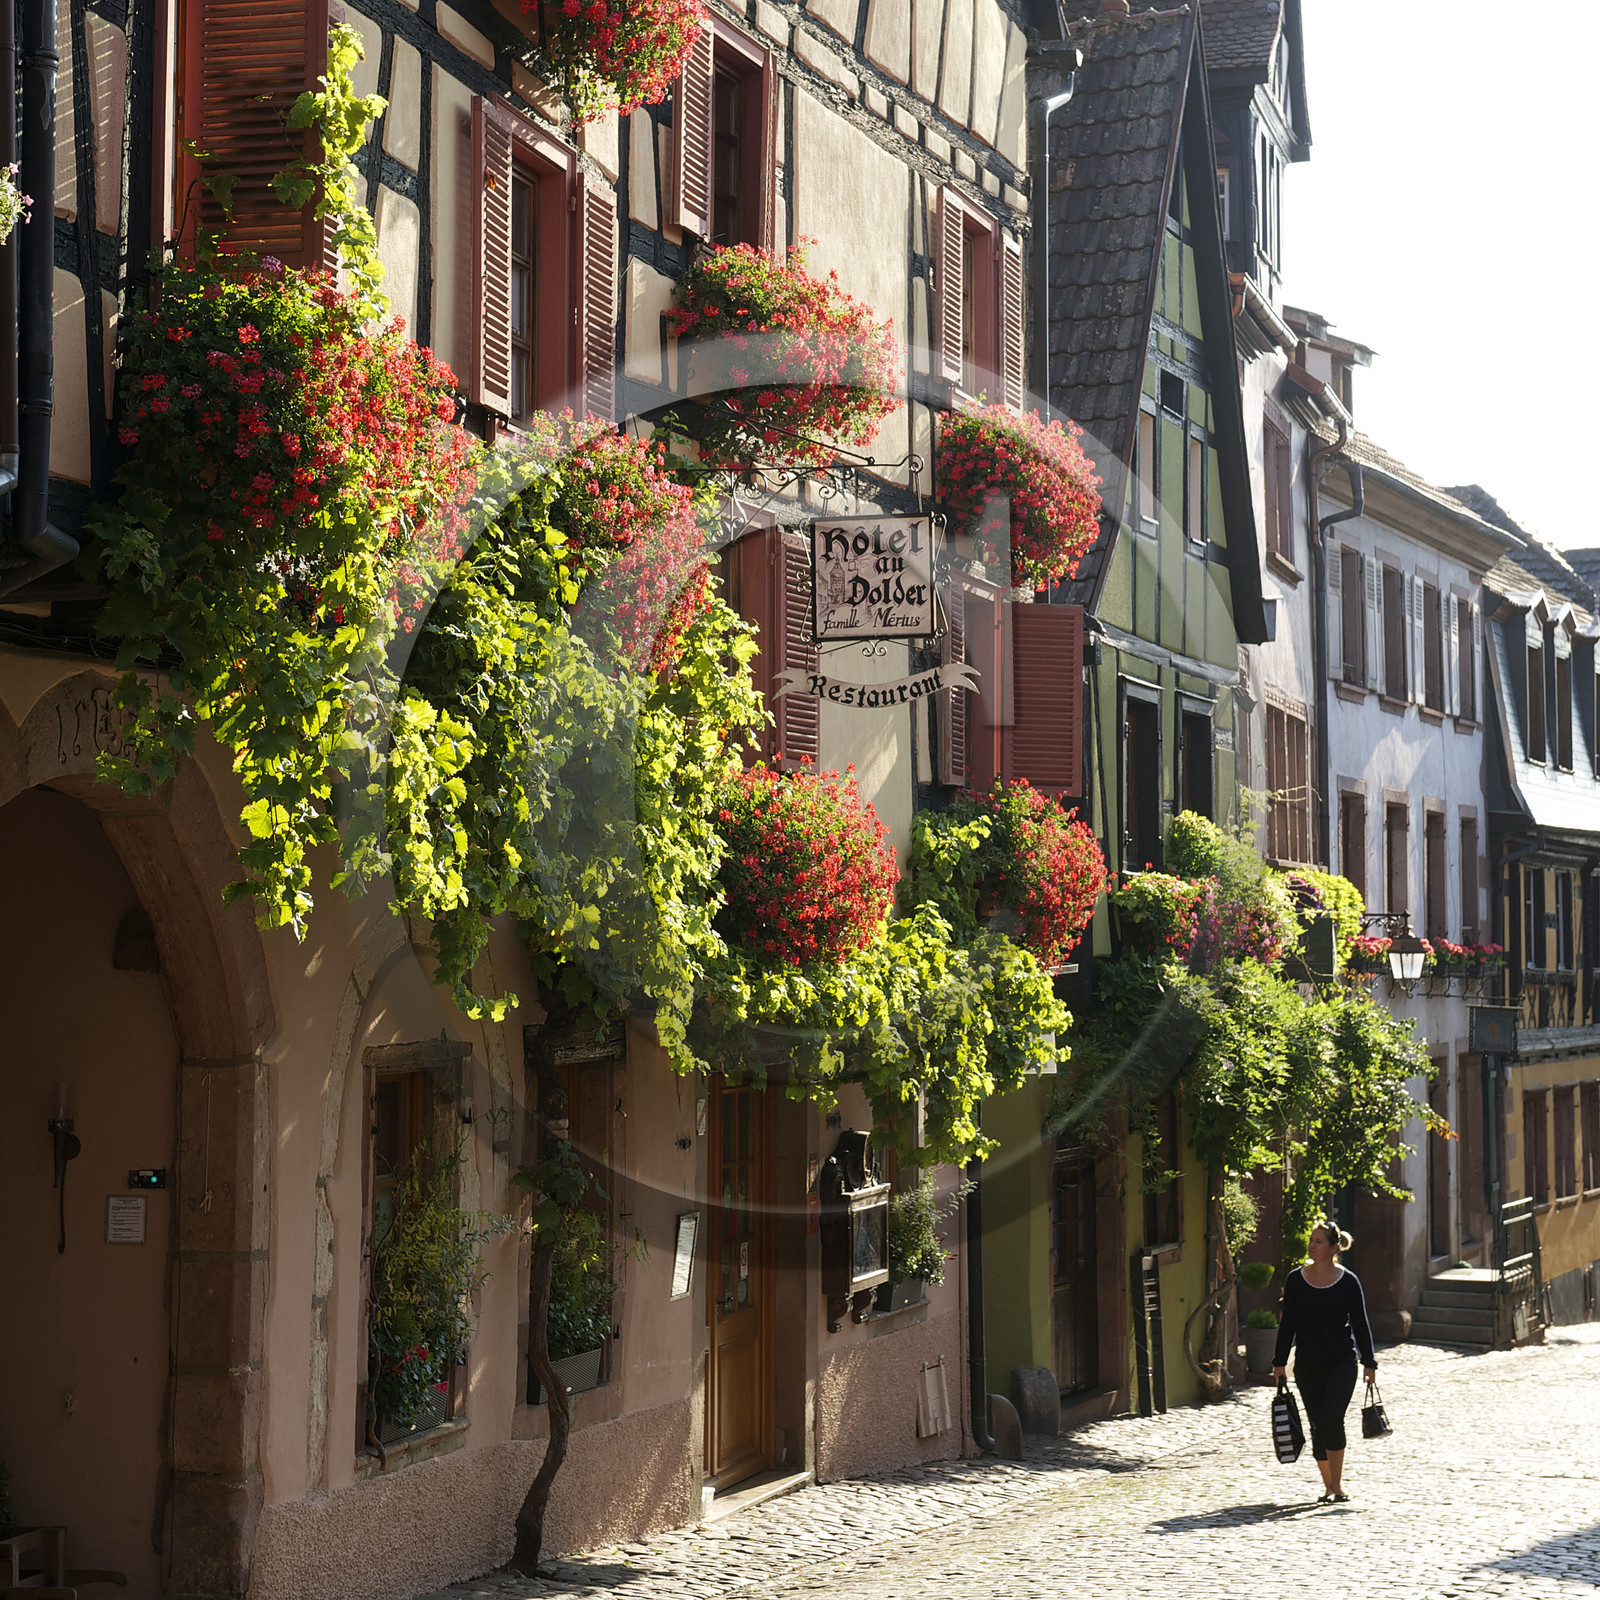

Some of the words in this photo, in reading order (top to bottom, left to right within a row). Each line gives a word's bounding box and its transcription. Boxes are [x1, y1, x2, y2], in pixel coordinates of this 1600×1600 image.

[820, 520, 925, 562] Hôtel
[875, 556, 906, 574] au
[843, 573, 927, 607] Dolder
[821, 608, 862, 635] famille
[873, 606, 924, 628] Mérius
[807, 668, 944, 708] Restaurant
